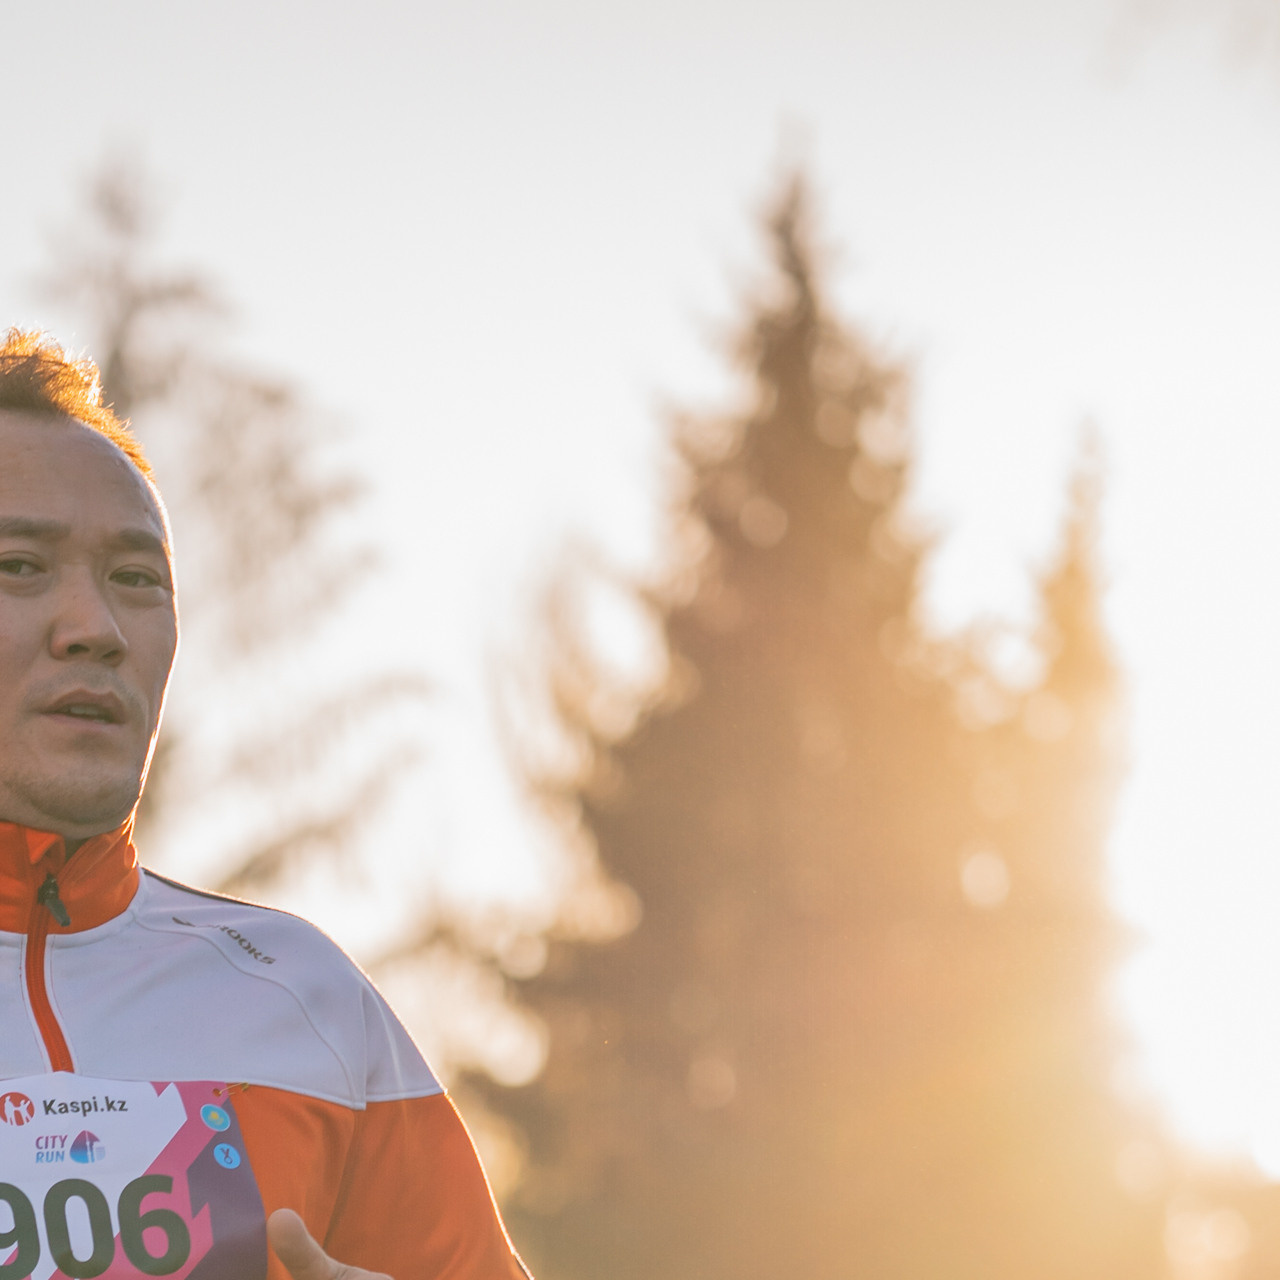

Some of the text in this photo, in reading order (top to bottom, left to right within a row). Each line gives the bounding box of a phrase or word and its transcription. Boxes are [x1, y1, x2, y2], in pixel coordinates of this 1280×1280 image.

[216, 924, 277, 965] OOKS
[42, 1096, 128, 1117] Kaspi.kz
[35, 1134, 68, 1150] CITY
[36, 1150, 66, 1164] RUN
